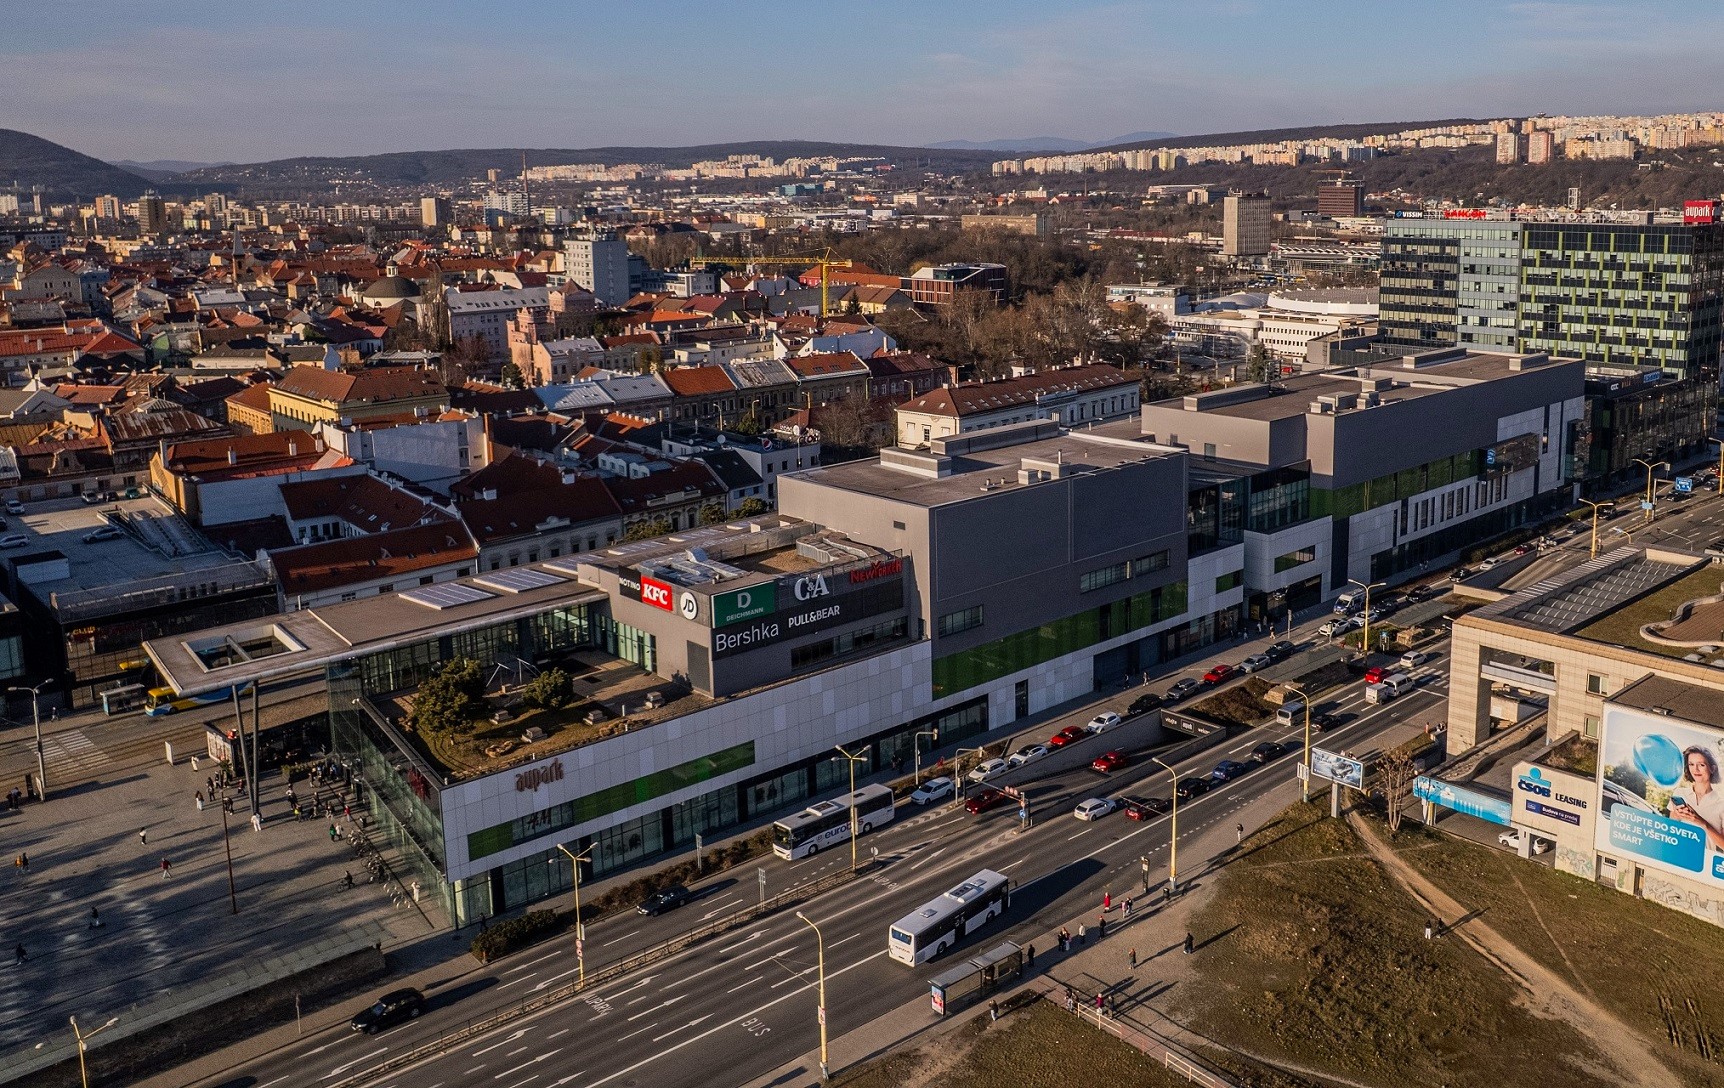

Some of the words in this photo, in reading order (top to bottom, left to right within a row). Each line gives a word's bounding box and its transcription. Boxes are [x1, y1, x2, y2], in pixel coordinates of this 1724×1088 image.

[1685, 205, 1710, 219] aupark
[619, 577, 641, 591] NOTINO
[643, 583, 668, 605] KFC
[794, 574, 830, 601] C&A
[683, 598, 694, 613] JD
[726, 607, 764, 622] DEICHMANN
[788, 605, 840, 628] PULL&BEAR
[716, 623, 779, 652] Bershka
[515, 757, 564, 792] aupark
[1518, 779, 1551, 798] ČSOB
[1555, 793, 1588, 809] LEASING
[824, 818, 864, 839] eurobs
[1613, 819, 1631, 831] KDE
[1632, 824, 1642, 834] JE
[1643, 828, 1679, 846] VŠETKO
[1614, 809, 1653, 827] VSTÚPTE
[1654, 821, 1669, 831] DO
[1670, 825, 1701, 843] SVETA,
[1612, 831, 1643, 846] SMART
[741, 1017, 771, 1037] BUS
